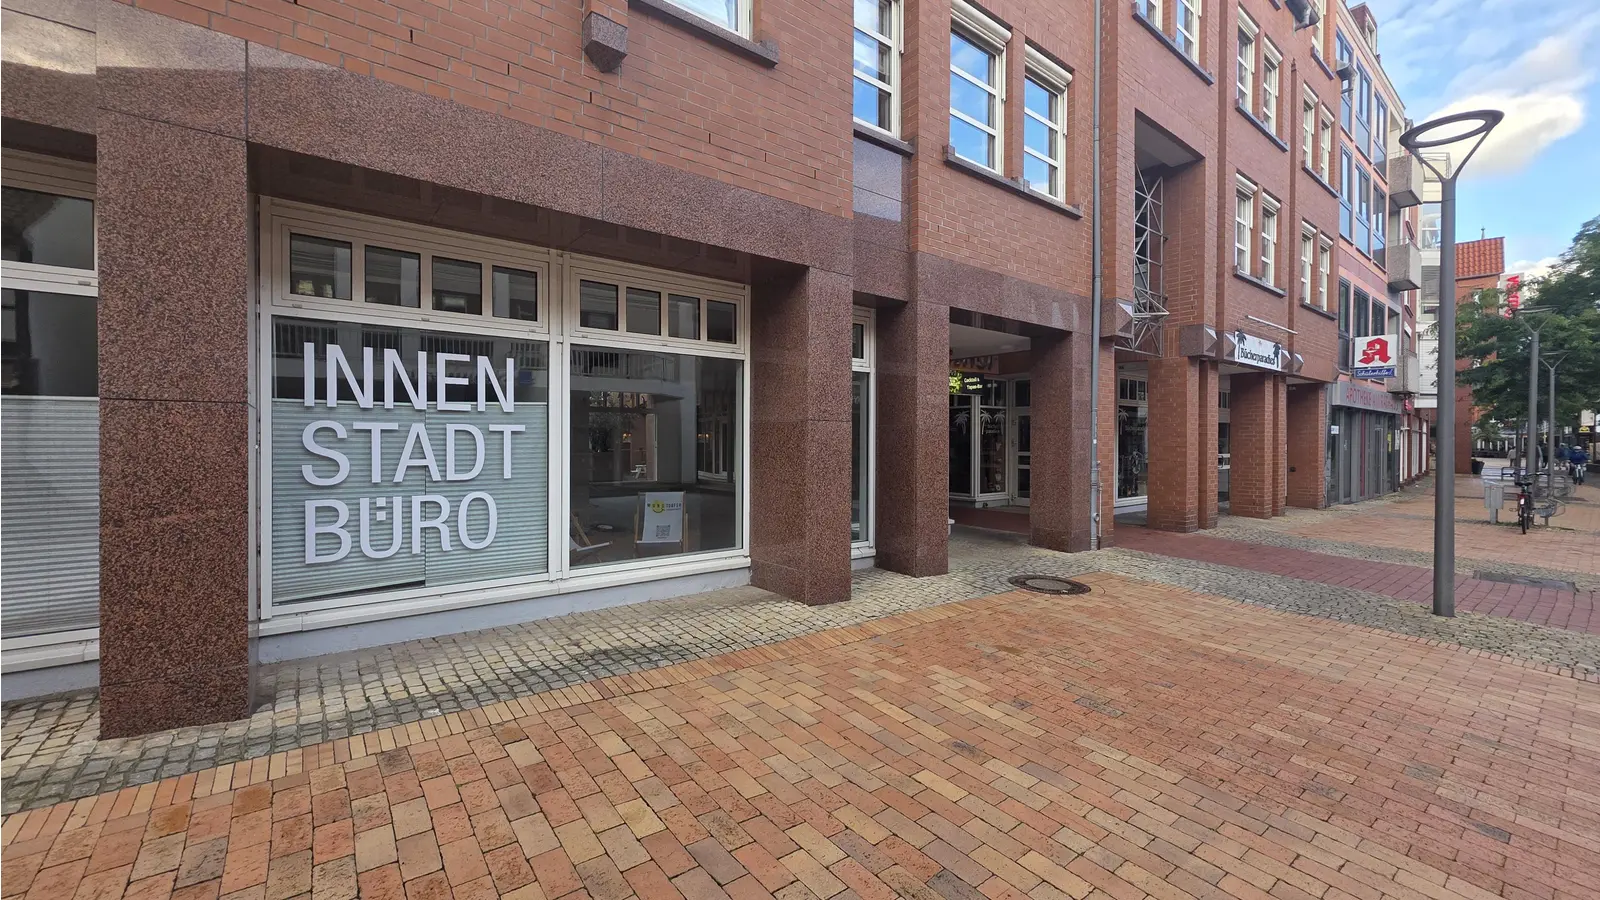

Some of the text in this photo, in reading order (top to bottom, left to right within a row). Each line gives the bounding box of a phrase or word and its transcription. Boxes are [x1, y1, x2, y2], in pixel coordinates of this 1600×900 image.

[303, 341, 515, 413] INNEN
[1240, 347, 1276, 366] Bücherparadies
[1346, 387, 1372, 406] APOTHEKE
[301, 420, 526, 486] STADT
[304, 491, 498, 564] BÜRO
